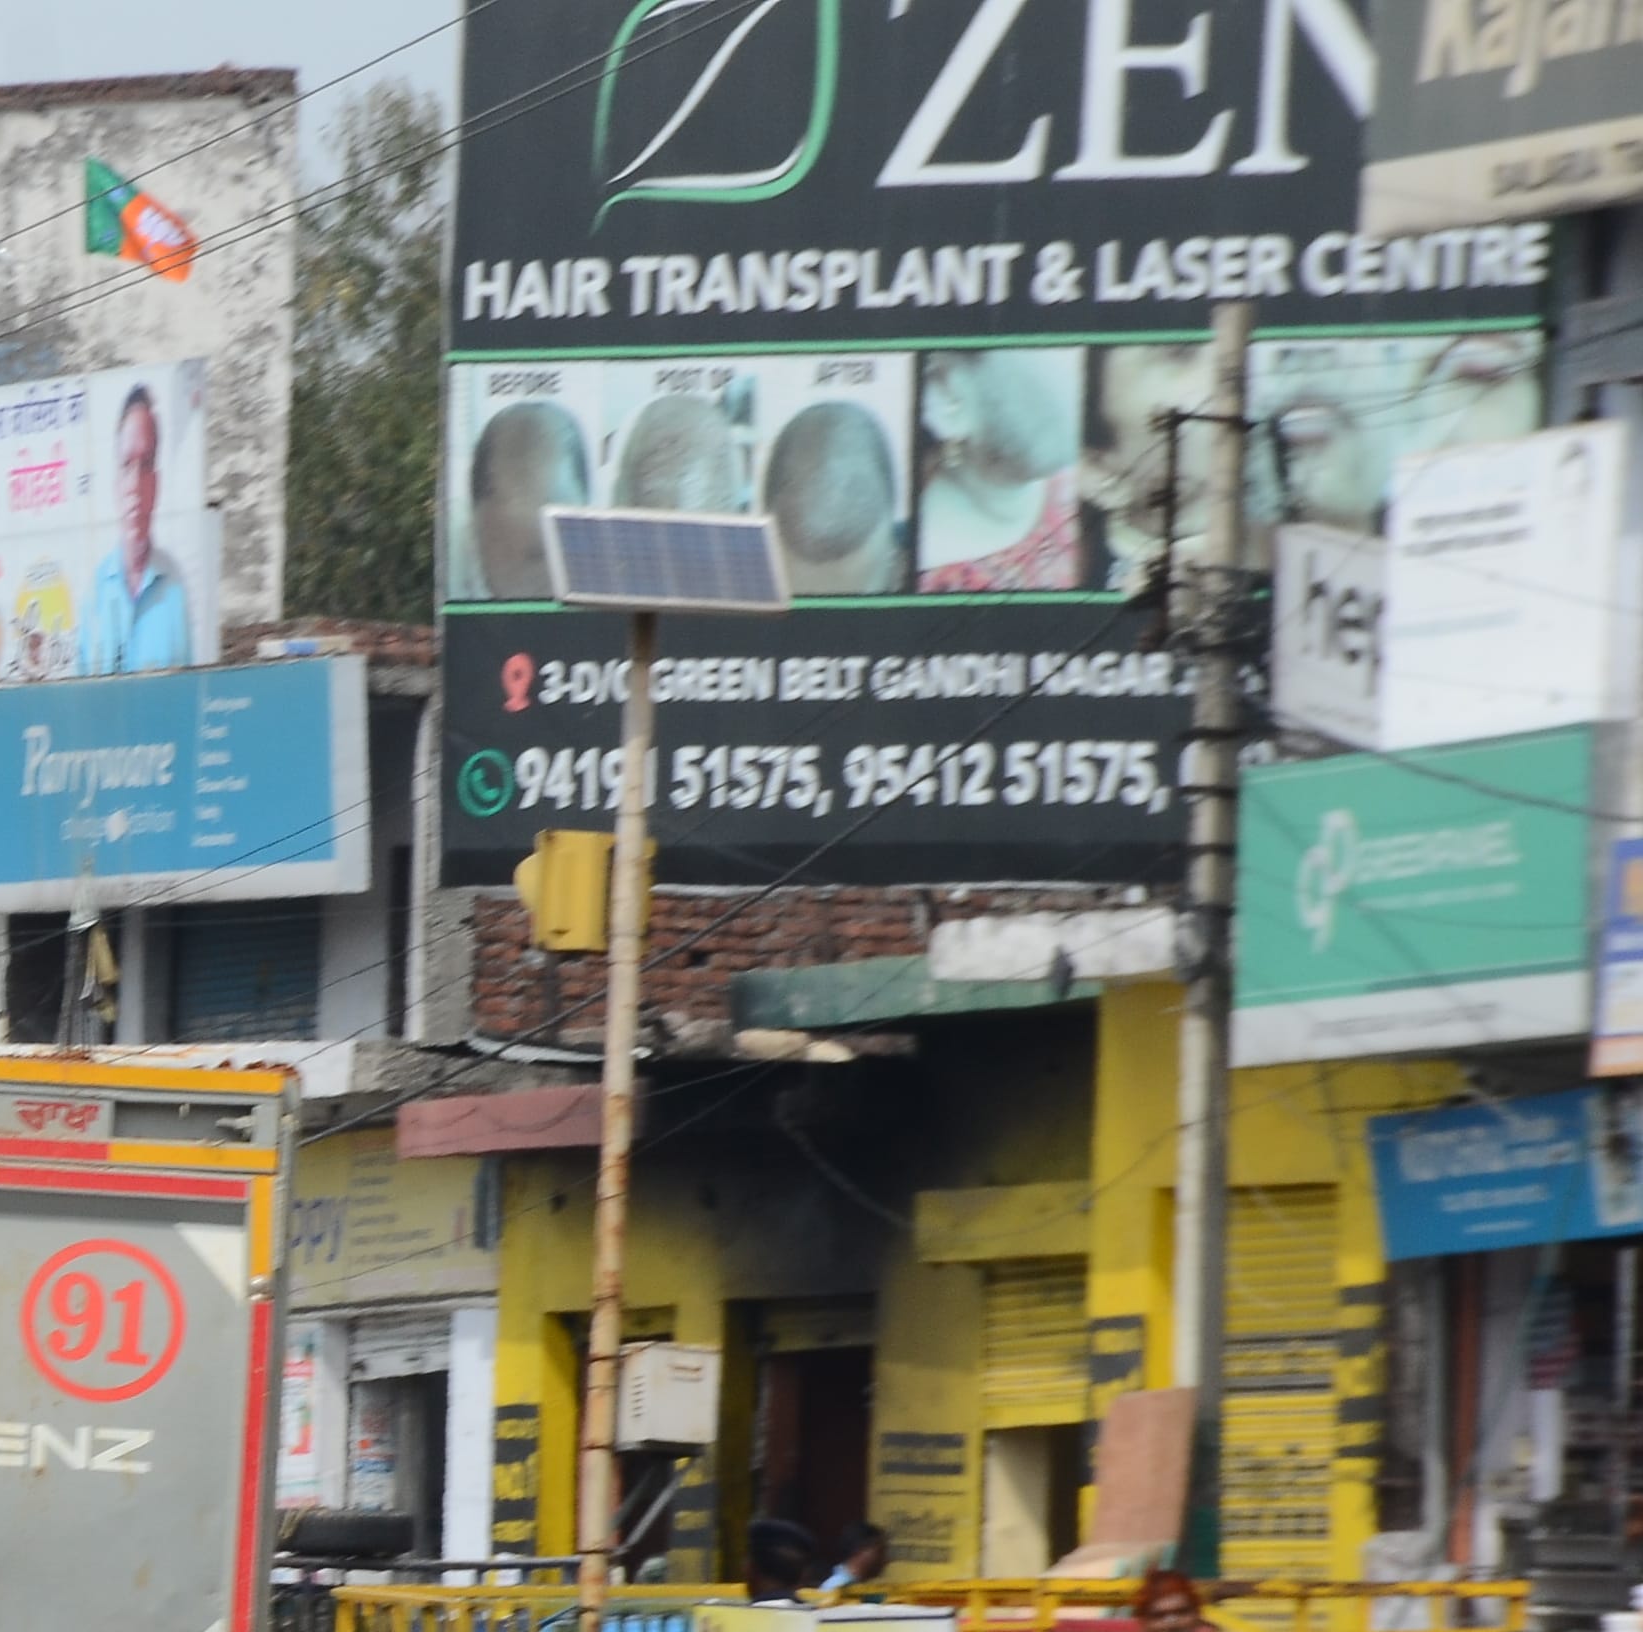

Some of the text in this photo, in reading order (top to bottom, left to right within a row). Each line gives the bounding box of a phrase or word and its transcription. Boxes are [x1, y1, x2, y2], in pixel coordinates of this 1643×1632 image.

[1417, 0, 1643, 98] Kajar
[463, 221, 1553, 321] HAIR TRANSPLANT & LASER CENTRE
[647, 657, 777, 703] GREEN
[778, 656, 870, 701] BELT
[870, 655, 1027, 700] GANDHI
[1030, 651, 1175, 698] NAGAR
[669, 745, 834, 818] 51575,
[842, 742, 995, 809] 95412
[1002, 739, 1172, 815] 51575,
[46, 1272, 149, 1366] 91
